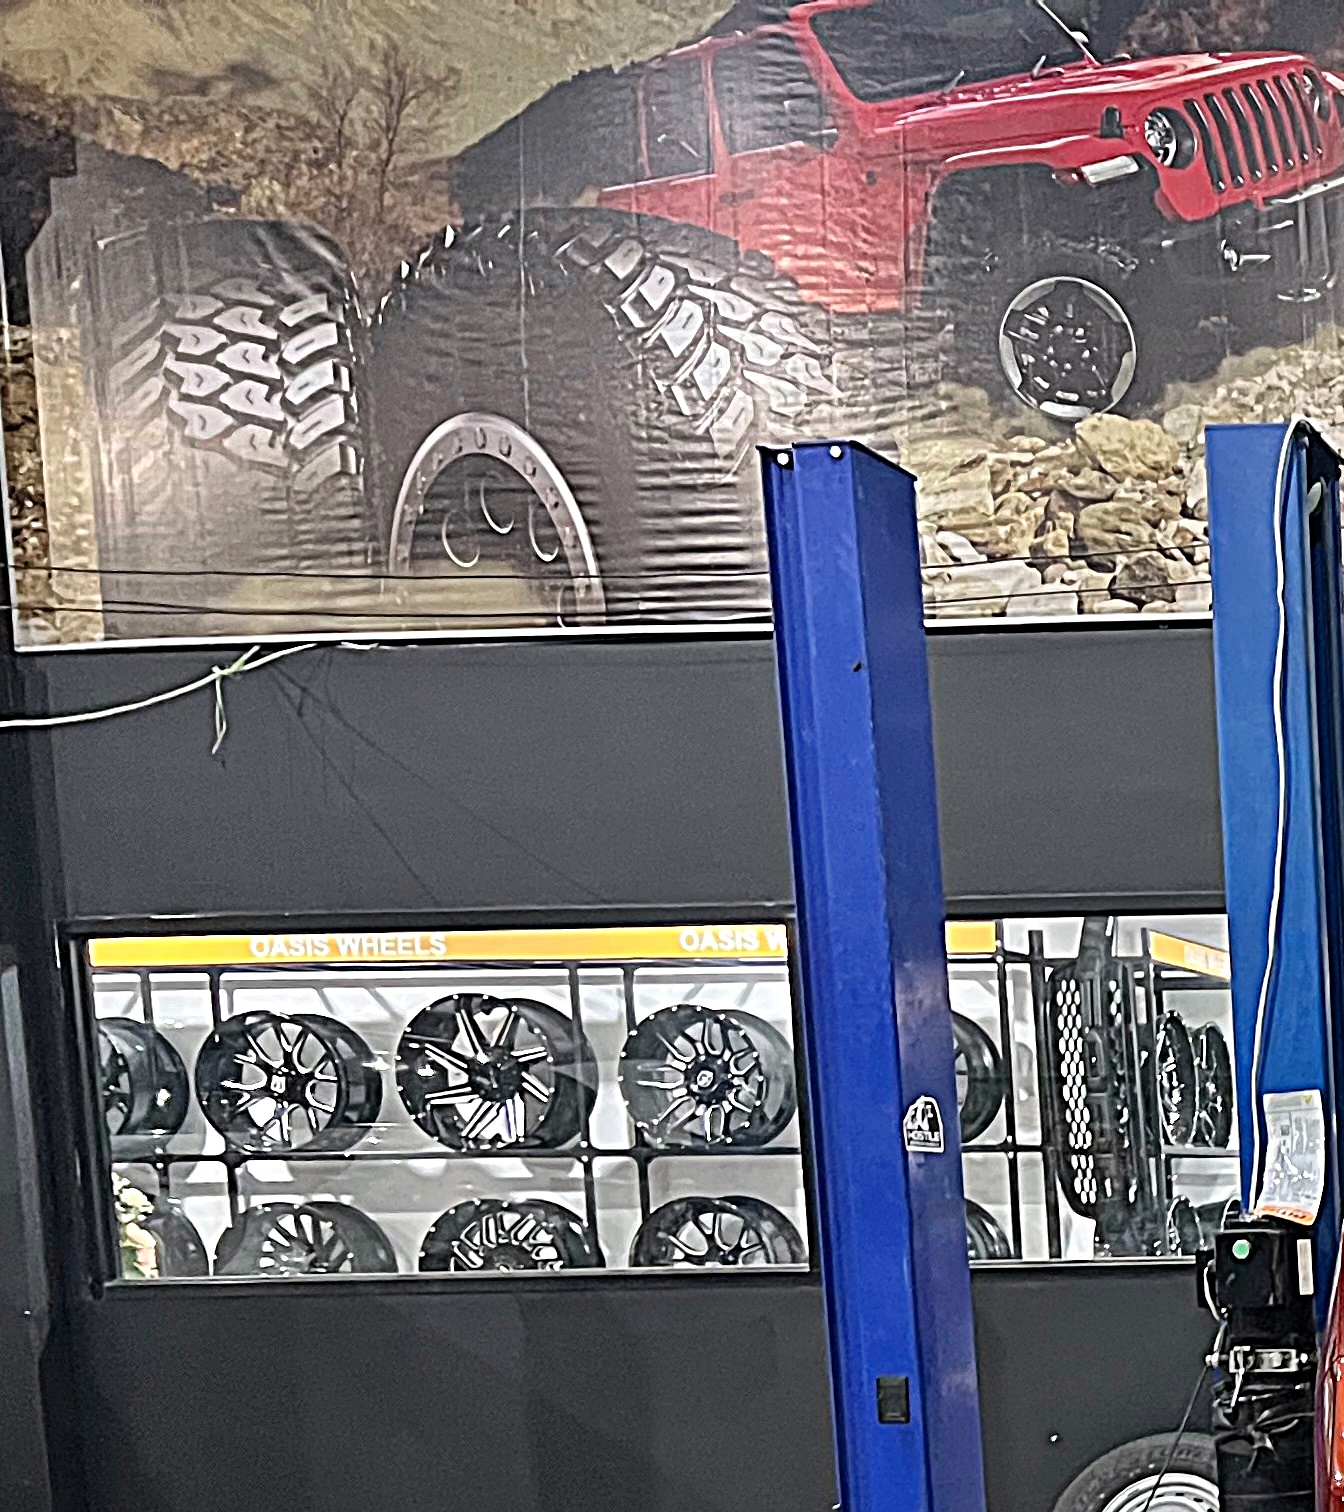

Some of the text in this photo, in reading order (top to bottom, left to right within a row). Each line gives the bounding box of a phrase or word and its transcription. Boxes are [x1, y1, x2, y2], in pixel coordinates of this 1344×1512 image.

[249, 933, 448, 958] OASIS WHEELS
[680, 929, 761, 953] OASIS
